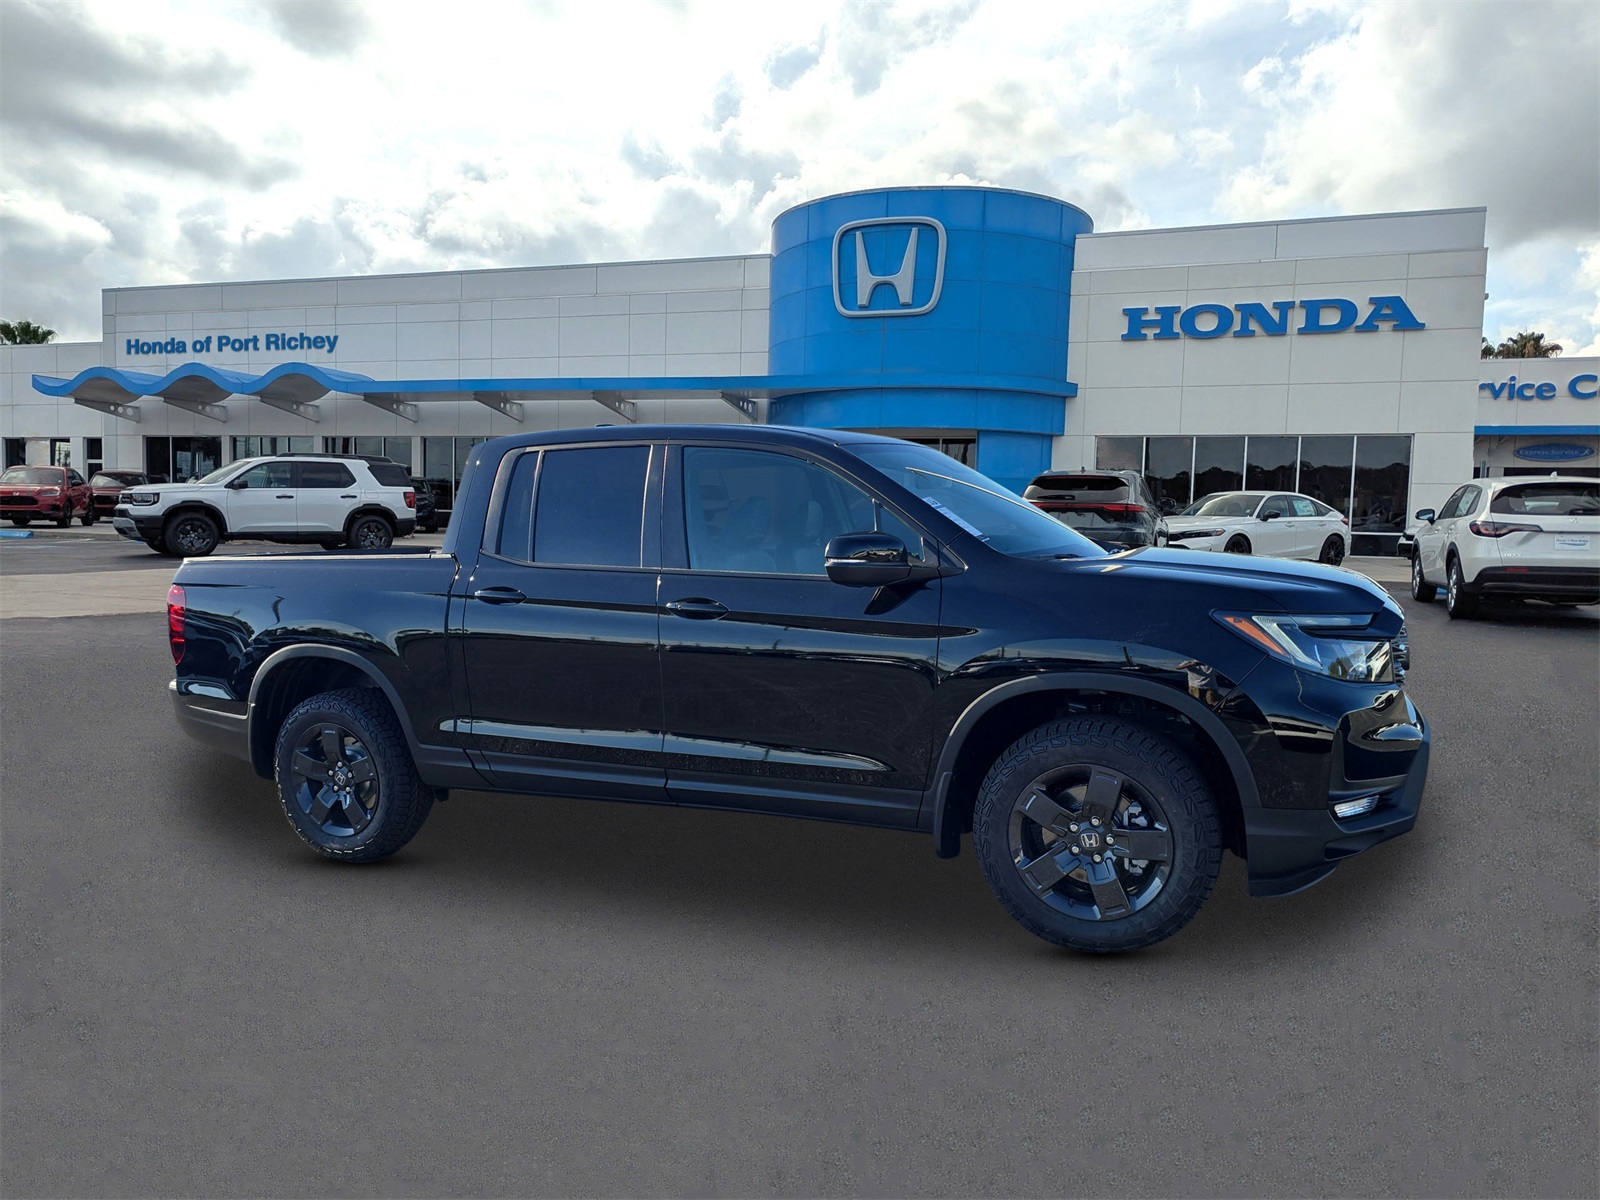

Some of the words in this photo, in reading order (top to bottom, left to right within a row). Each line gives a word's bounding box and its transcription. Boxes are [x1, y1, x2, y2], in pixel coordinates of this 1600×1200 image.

[1121, 295, 1426, 341] HONDA
[126, 337, 187, 355] Honda
[192, 335, 212, 353] of
[217, 334, 260, 352] Port
[265, 332, 339, 354] Richey
[1567, 373, 1600, 400] C
[1519, 448, 1549, 456] Express
